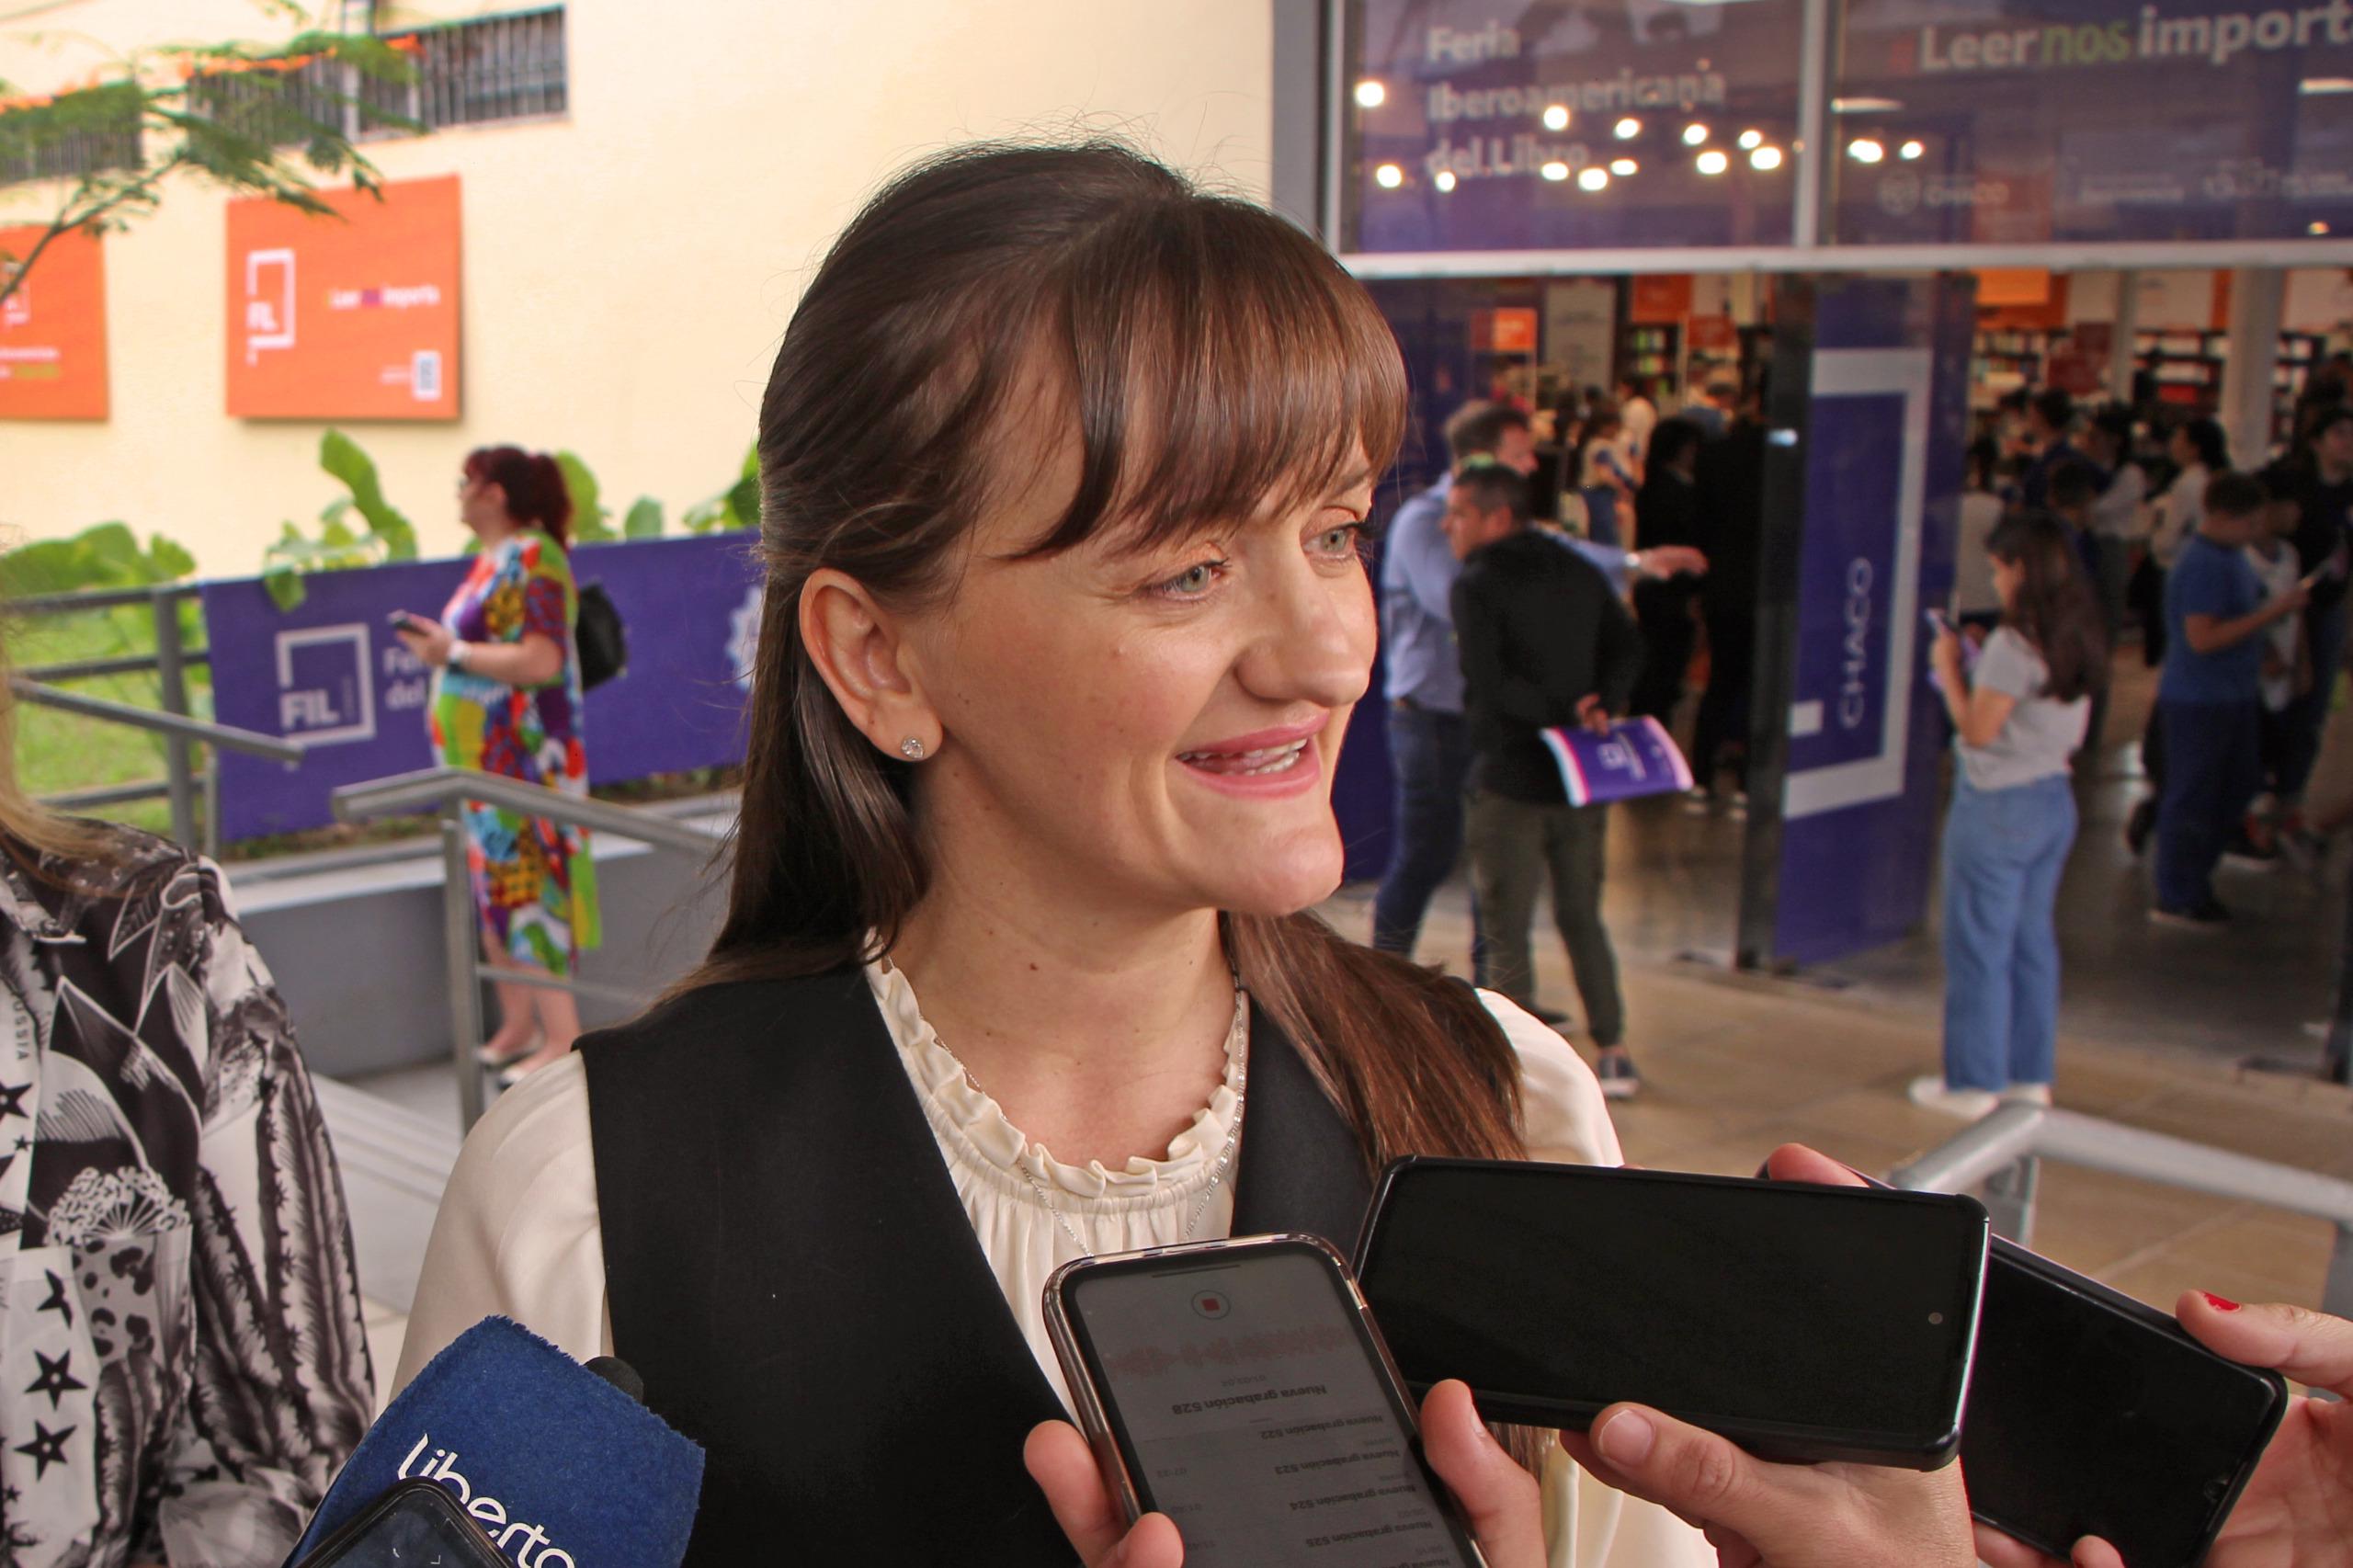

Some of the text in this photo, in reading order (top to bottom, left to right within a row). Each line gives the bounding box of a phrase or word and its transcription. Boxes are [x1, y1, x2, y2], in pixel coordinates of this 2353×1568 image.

[1427, 19, 1521, 62] Feria
[1427, 67, 1726, 120] Iberoamericana
[1427, 133, 1590, 179] del Libro
[1838, 557, 1874, 729] CHACO
[280, 688, 340, 730] FIL
[1172, 1384, 1327, 1415] Nueva grabación 528
[1261, 1415, 1383, 1440] Nueva grabación 522
[1301, 1453, 1361, 1471] grabación
[1362, 1449, 1401, 1460] Nueva
[1289, 1484, 1417, 1510] Nueva grabación 524
[1305, 1520, 1434, 1548] Nueva grabación 525
